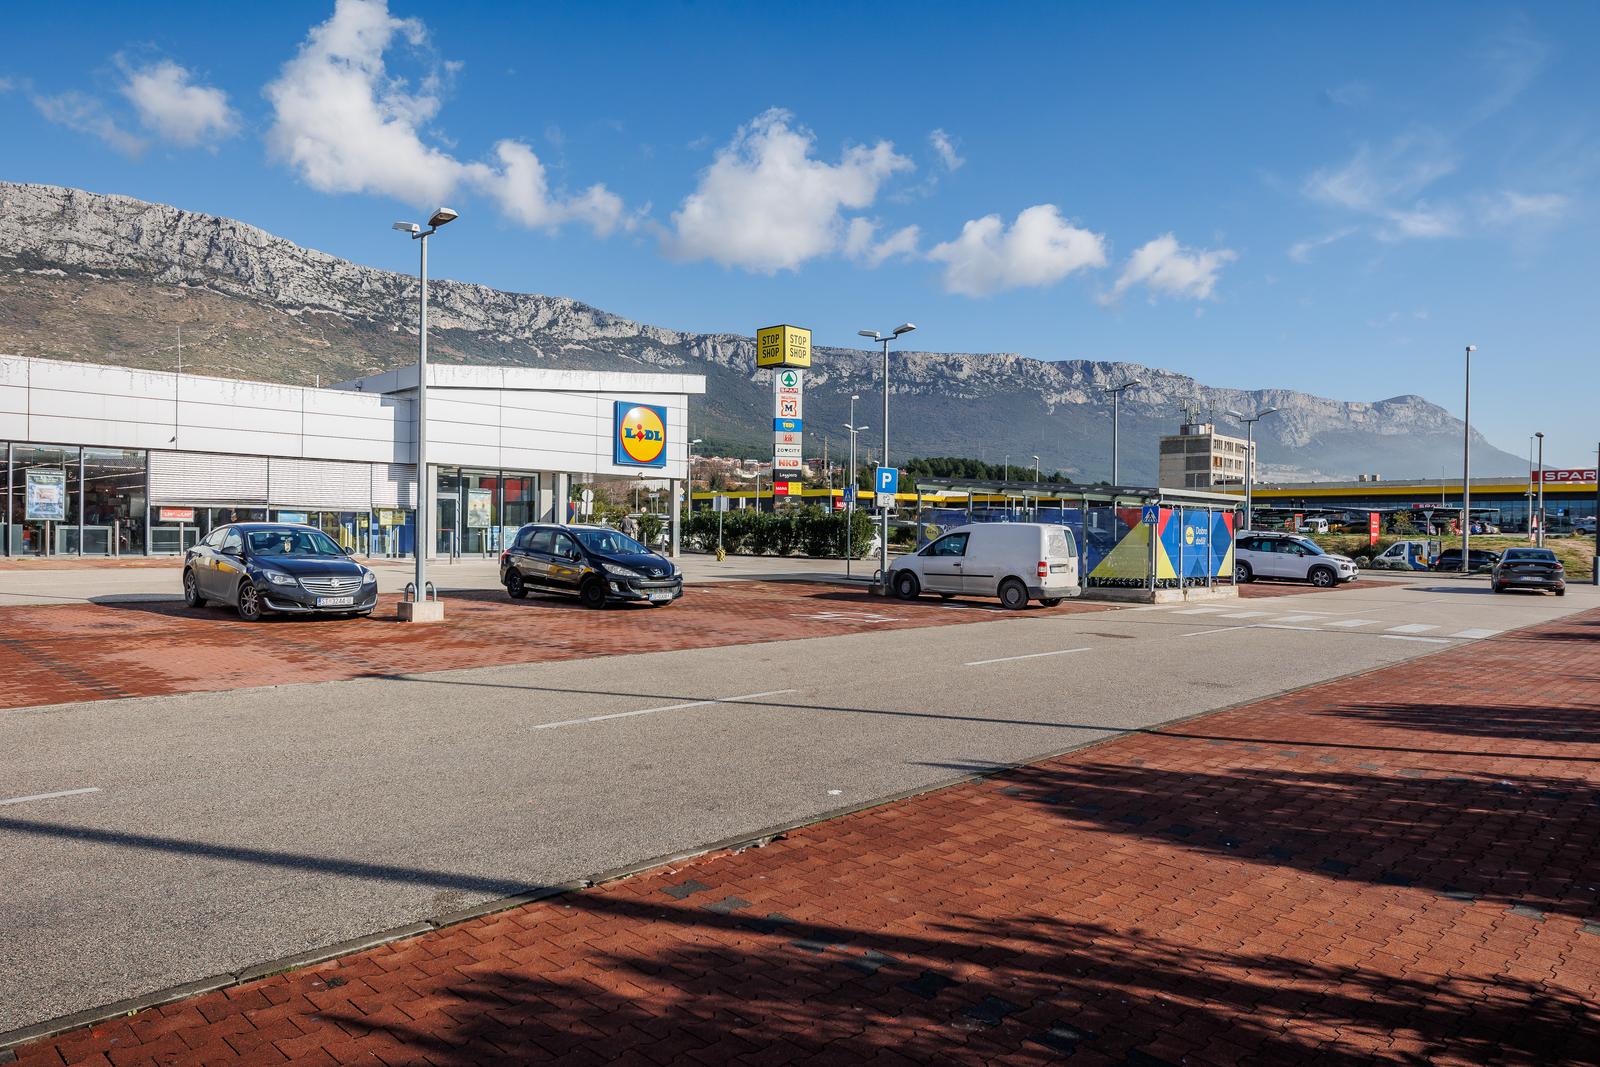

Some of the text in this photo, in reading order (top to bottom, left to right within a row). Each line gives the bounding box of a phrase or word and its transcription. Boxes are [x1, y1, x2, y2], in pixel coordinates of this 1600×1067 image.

[762, 333, 780, 346] STOP
[790, 333, 807, 346] STOP
[762, 347, 780, 359] SHOP
[790, 347, 807, 359] SHOP
[785, 404, 793, 412] M
[624, 423, 663, 442] LIDL
[778, 459, 799, 467] NKD
[882, 472, 893, 489] P
[1544, 471, 1596, 481] SPAR
